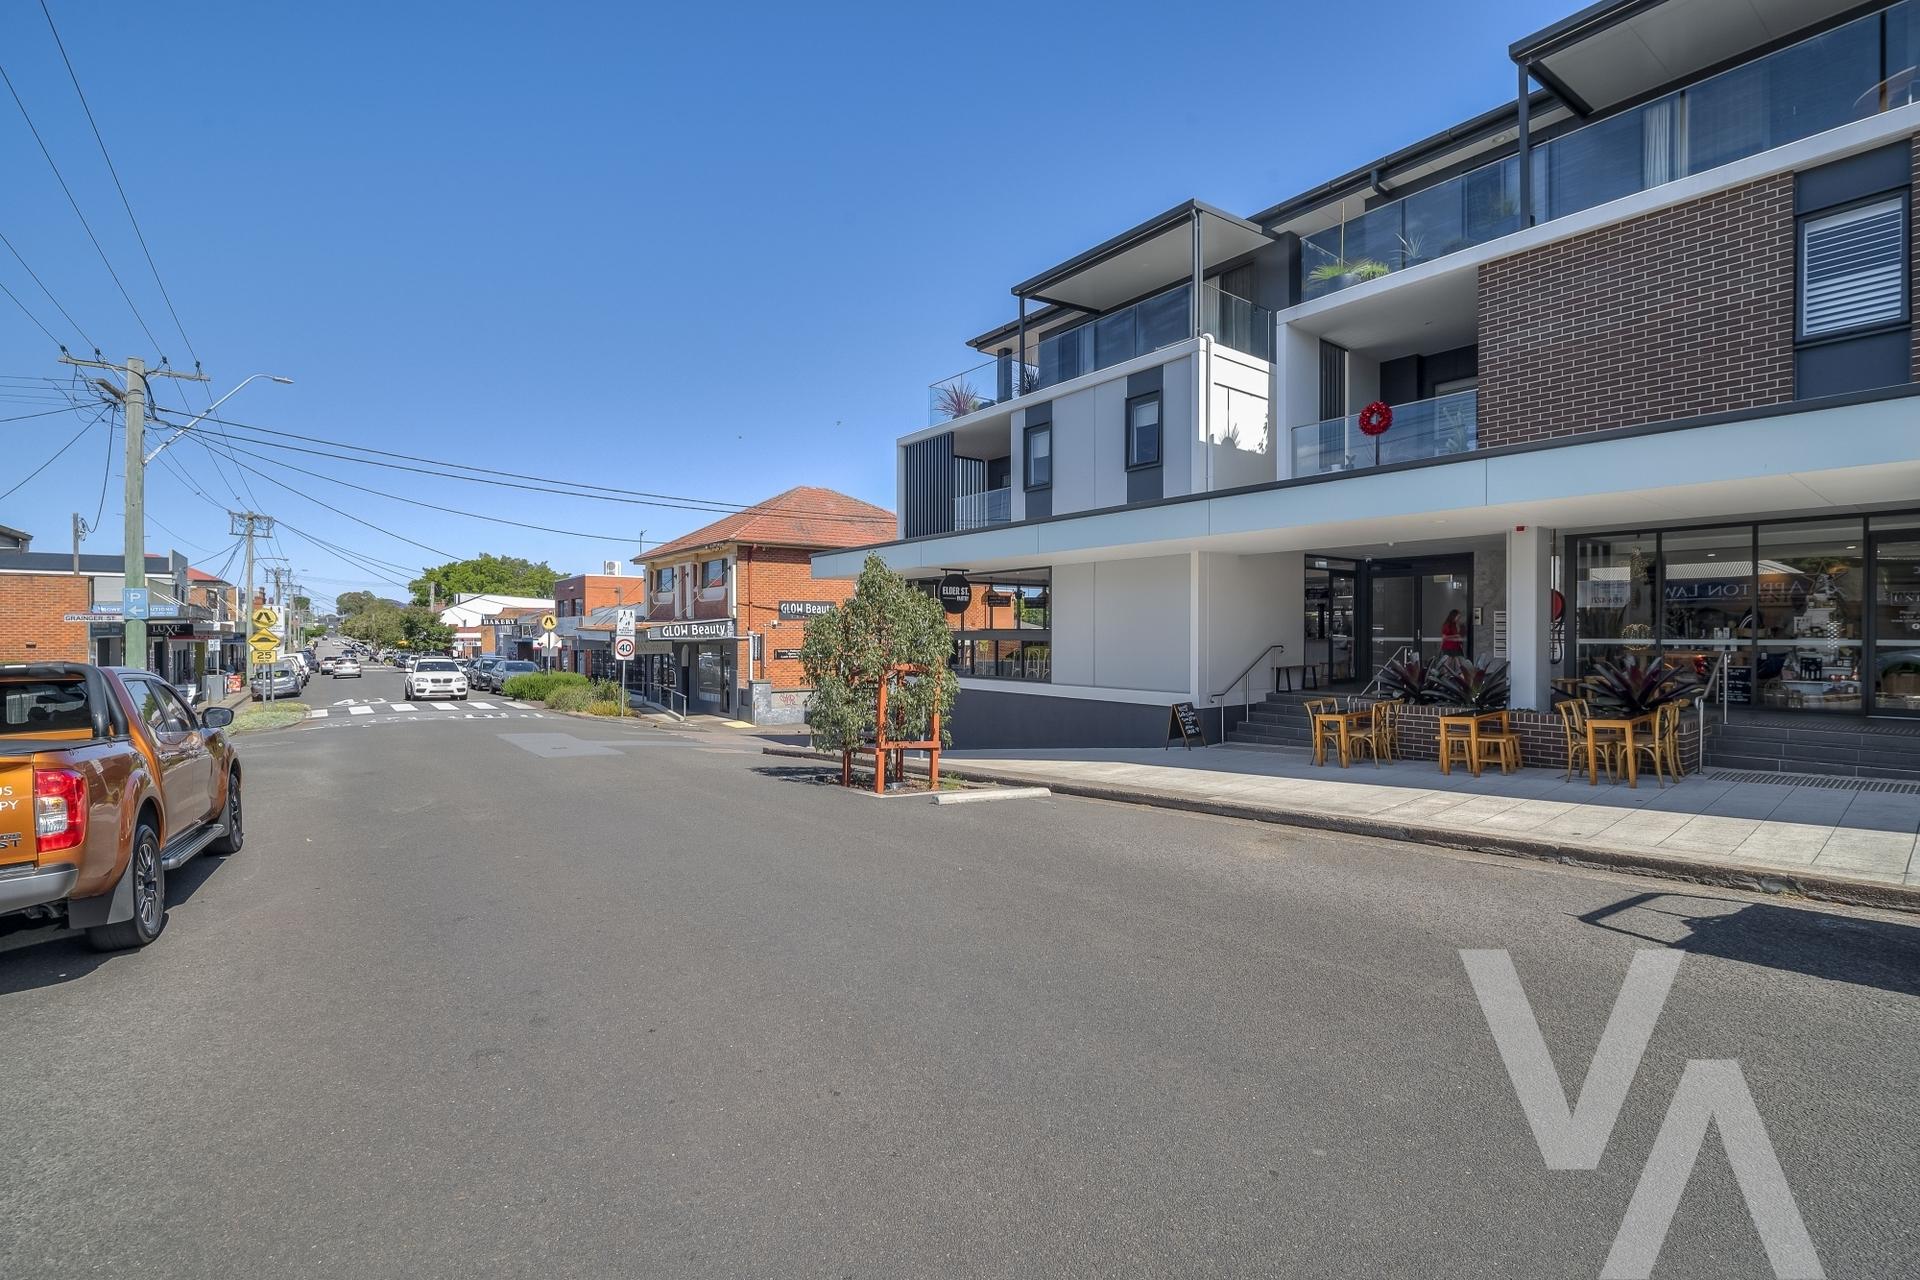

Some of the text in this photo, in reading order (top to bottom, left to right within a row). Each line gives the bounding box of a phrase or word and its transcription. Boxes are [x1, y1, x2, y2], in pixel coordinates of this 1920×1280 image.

[942, 586, 960, 595] ELDER
[781, 603, 835, 614] GLOW Beaut
[152, 624, 181, 636] LUXE
[662, 624, 688, 637] GLOW
[691, 624, 726, 637] Beauty
[619, 643, 632, 652] 40
[257, 651, 272, 659] 25
